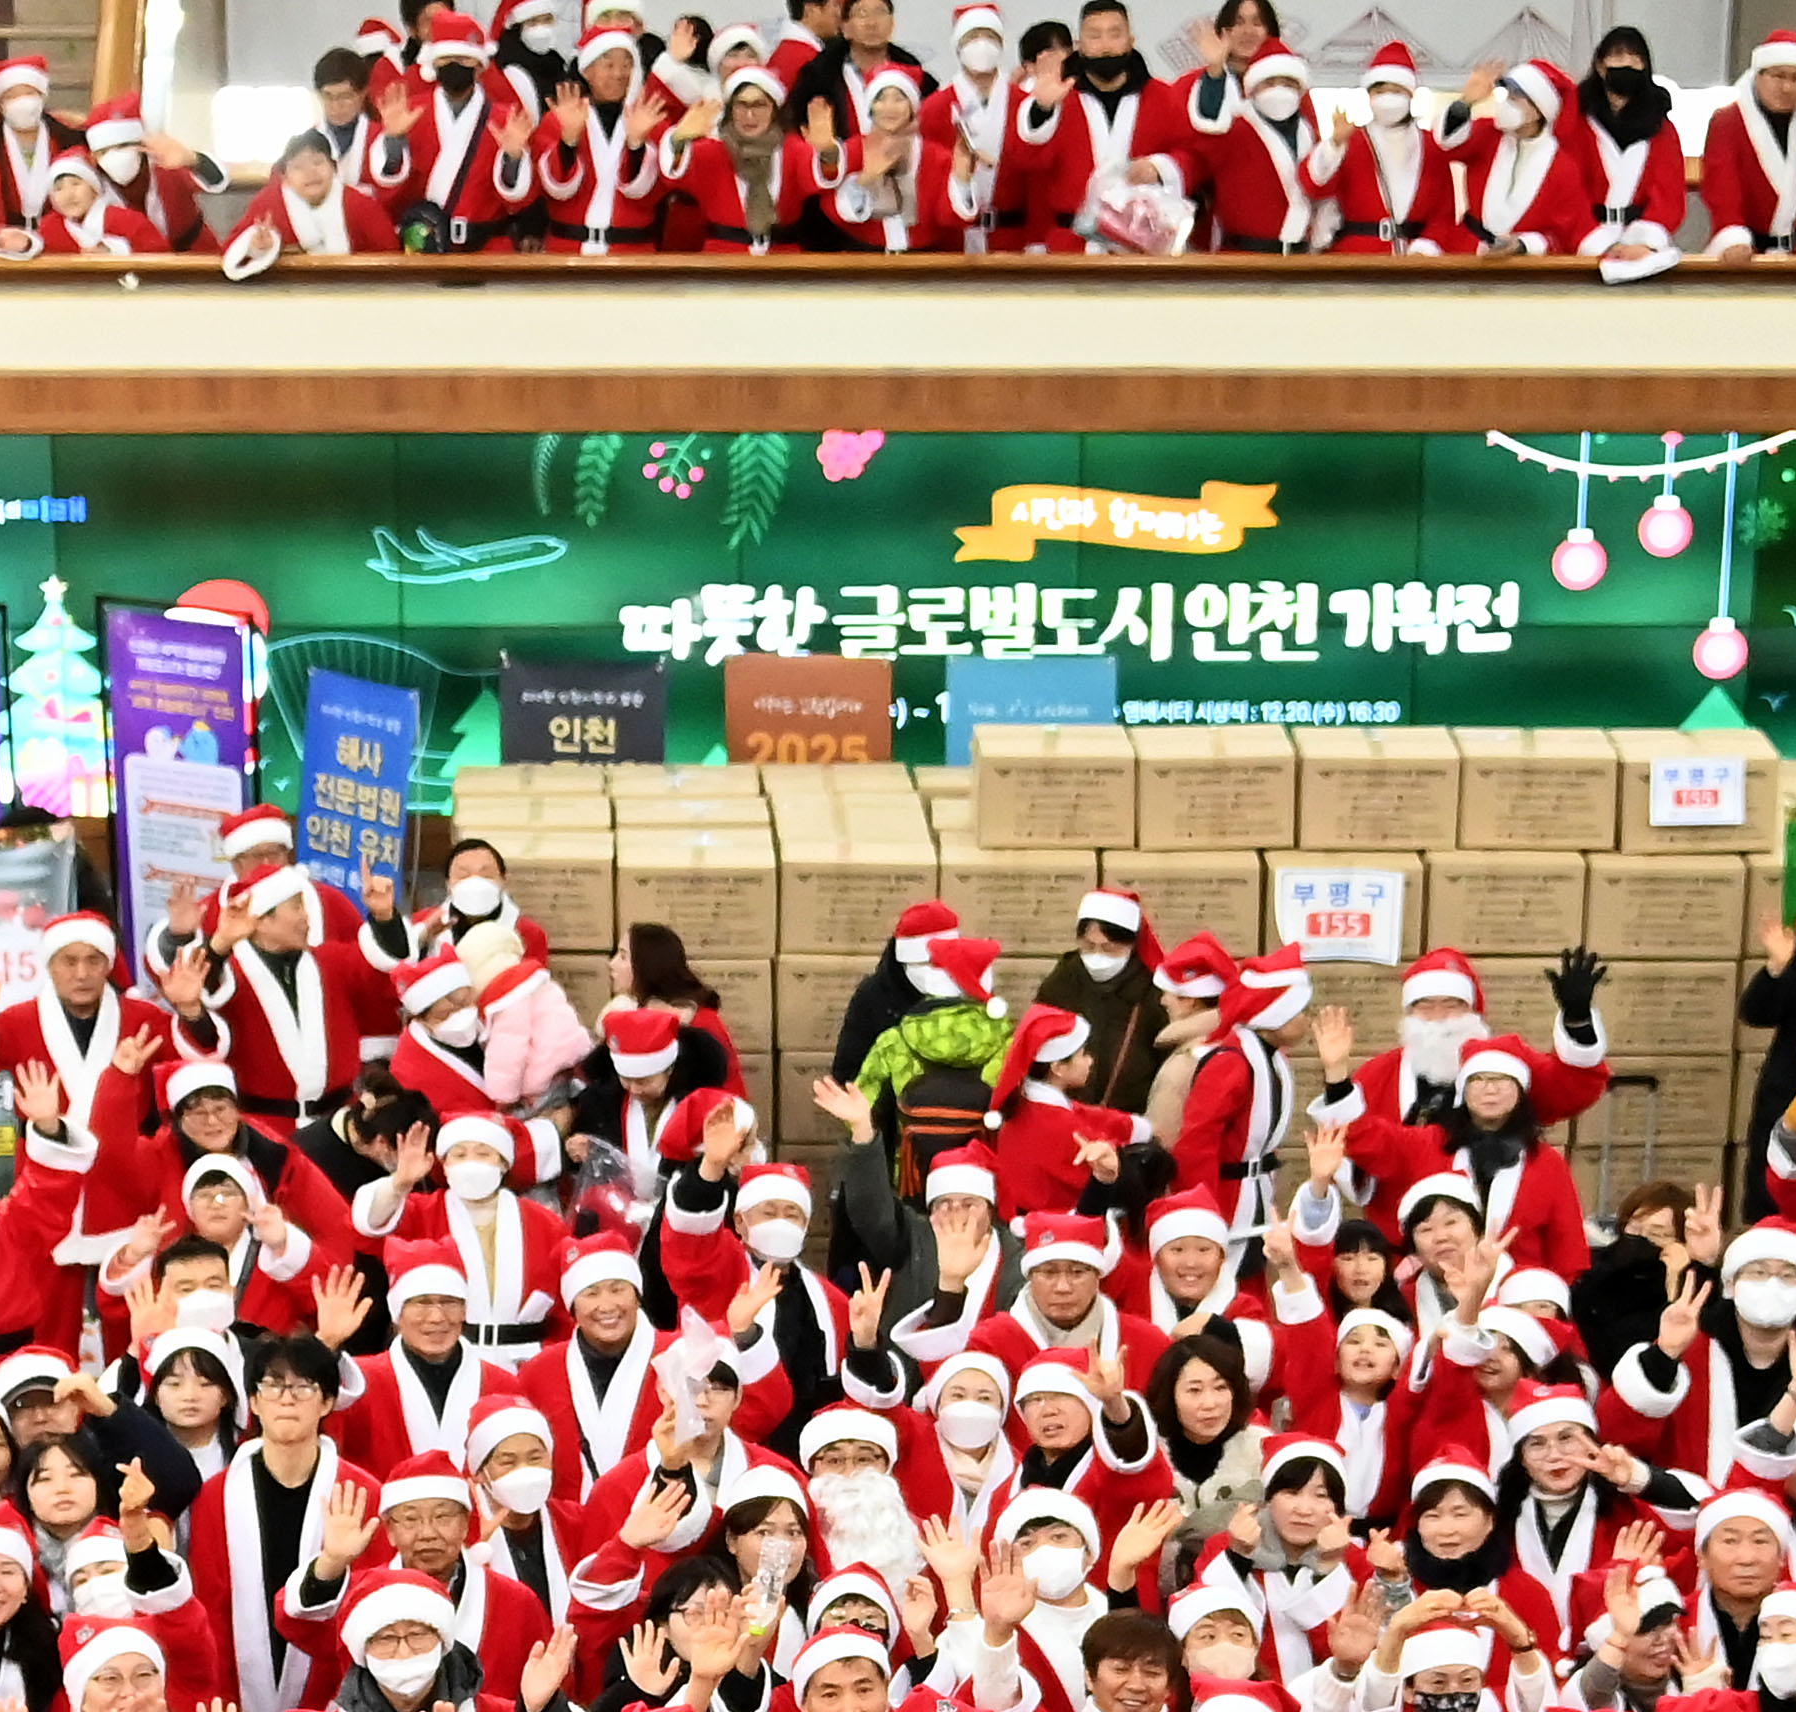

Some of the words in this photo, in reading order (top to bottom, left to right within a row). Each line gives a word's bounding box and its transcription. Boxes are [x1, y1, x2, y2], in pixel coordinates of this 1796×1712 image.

[1011, 497, 1099, 531] 시민과
[618, 583, 827, 667] 따뜻한
[1183, 580, 1320, 662] 인천
[1328, 580, 1521, 656] 기획전
[548, 715, 618, 755] 인천
[745, 731, 869, 763] 2025
[336, 735, 383, 778] 해사
[313, 772, 401, 828] 전문법원
[306, 815, 352, 860] 인천
[1292, 882, 1386, 908] 부평구
[1316, 913, 1364, 937] 155
